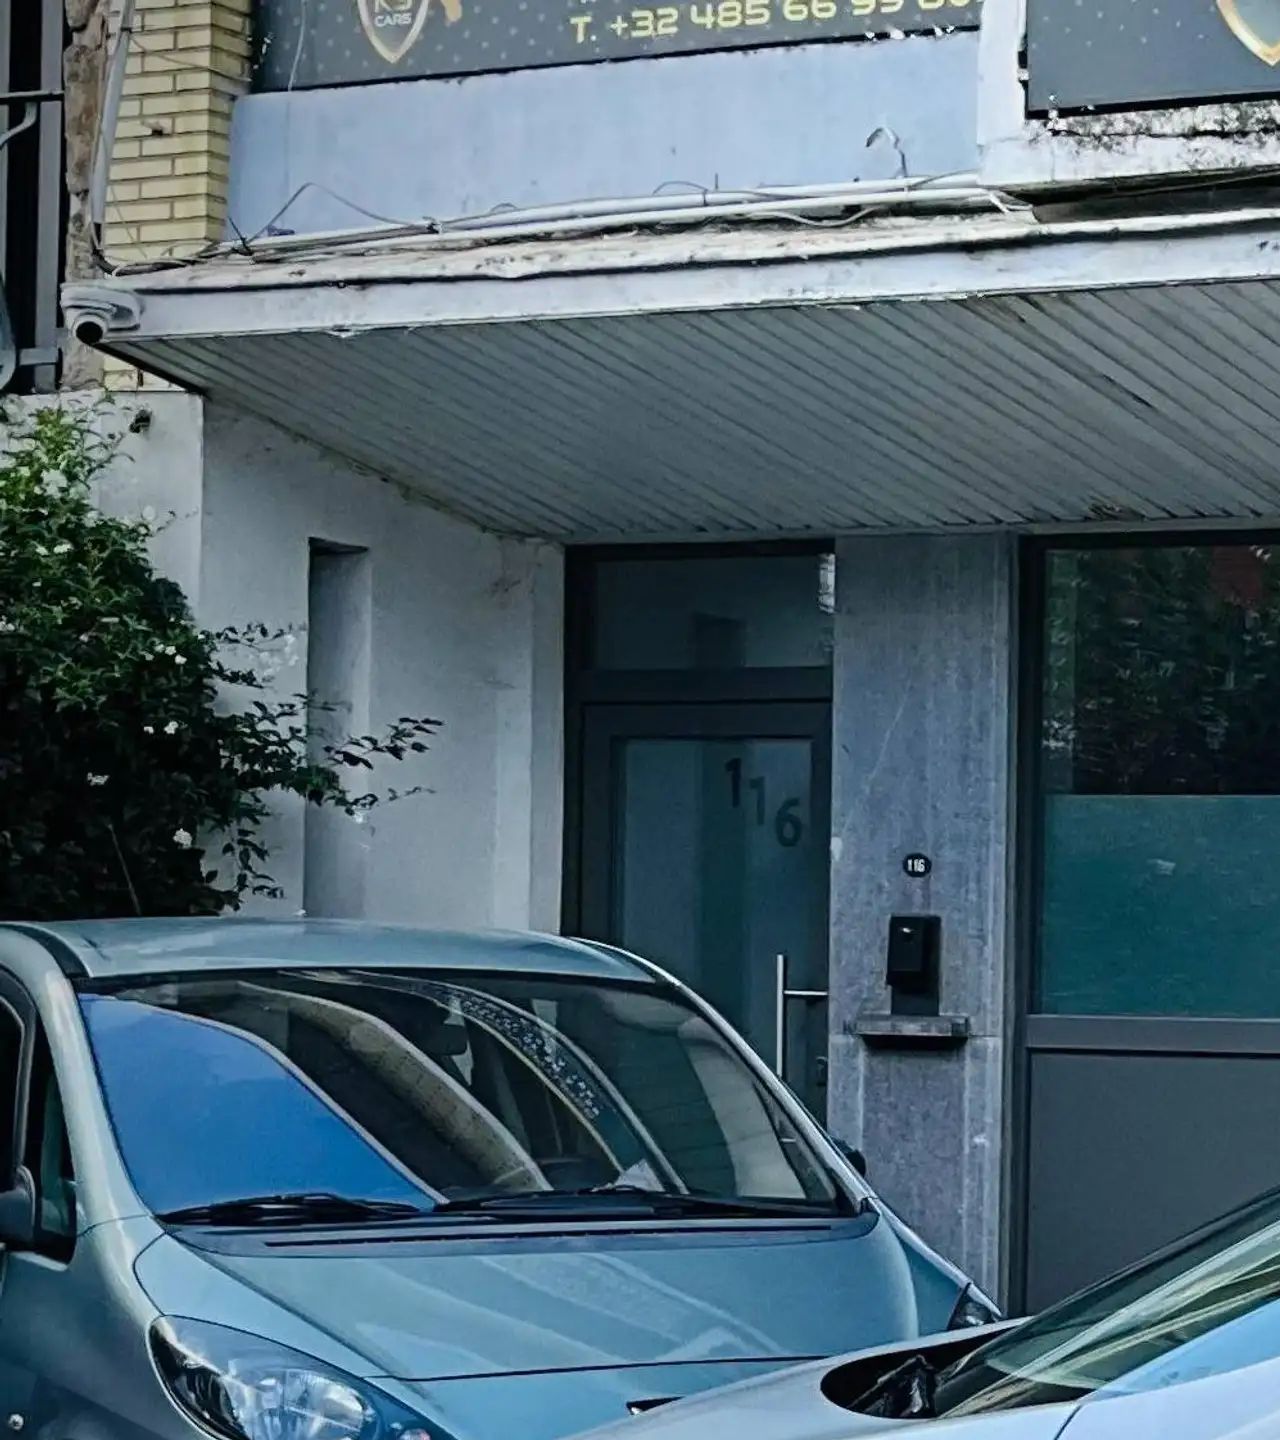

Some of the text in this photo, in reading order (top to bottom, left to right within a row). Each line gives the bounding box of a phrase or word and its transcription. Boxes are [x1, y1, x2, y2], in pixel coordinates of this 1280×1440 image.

[374, 12, 412, 27] CARS
[569, 15, 597, 43] T.
[610, 7, 679, 37] +32
[690, 0, 771, 29] 485
[725, 757, 803, 847] 116
[907, 858, 926, 872] 116
